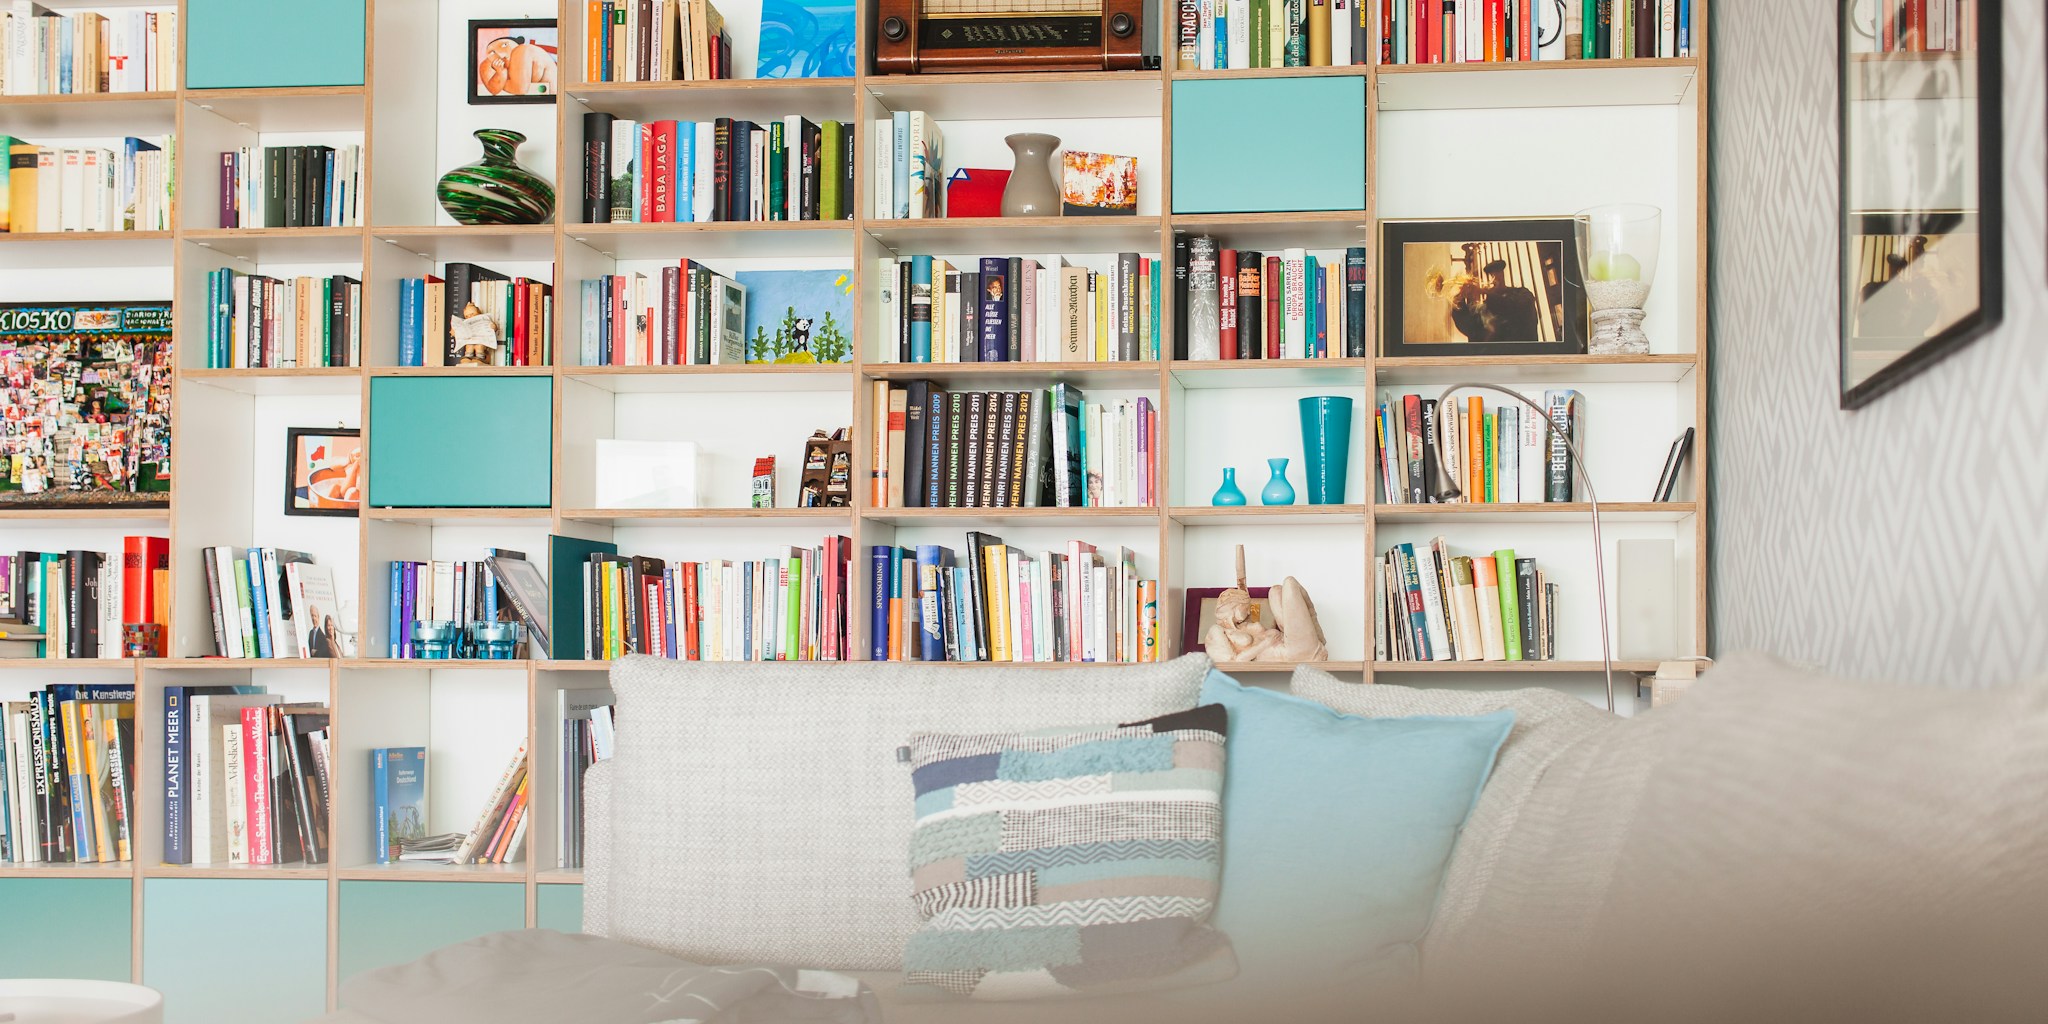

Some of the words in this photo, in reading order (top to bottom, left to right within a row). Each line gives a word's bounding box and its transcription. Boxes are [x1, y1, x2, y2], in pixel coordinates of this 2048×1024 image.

[1291, 15, 1300, 26] hat
[1291, 26, 1300, 45] Bibel
[1291, 45, 1300, 57] die
[657, 133, 667, 171] JAGA
[656, 175, 667, 212] BABA
[252, 279, 261, 307] ABGANG
[1088, 273, 1096, 292] PIPER
[1122, 260, 1130, 311] Buschkowsky
[1221, 308, 1229, 330] Michael
[933, 394, 941, 414] 2009
[952, 394, 961, 413] 2010
[971, 394, 980, 412] 2011
[989, 393, 998, 412] 2014
[1004, 393, 1014, 413] 2013
[1020, 393, 1029, 412] 2012
[932, 416, 940, 441] PREIS
[951, 415, 960, 440] PREIS
[970, 414, 979, 440] PREIS
[987, 414, 996, 440] PREIS
[1001, 414, 1011, 440] PREIS
[1017, 414, 1027, 440] PREIS
[931, 443, 940, 480] NANNEN
[950, 442, 959, 479] NANNEN
[968, 442, 977, 479] NANNEN
[985, 442, 994, 478] NANNEN
[998, 442, 1008, 479] NANNEN
[1014, 442, 1023, 479] NANNEN
[930, 482, 938, 508] HENRI
[949, 482, 958, 508] HENRI
[966, 482, 975, 508] HENRI
[982, 481, 991, 508] HENRI
[996, 481, 1005, 508] HENRI
[1011, 481, 1020, 508] HENRI
[780, 567, 788, 586] IRRE!
[75, 690, 88, 700] Die
[168, 710, 178, 744] MEER
[30, 696, 45, 795] EXPRESSIONISMUS
[228, 729, 238, 780] Volkslieder
[109, 749, 120, 787] CLASSICS
[168, 748, 179, 798] PLANET
[253, 739, 265, 785] Complete
[254, 785, 264, 803] The
[256, 838, 269, 862] Egon
